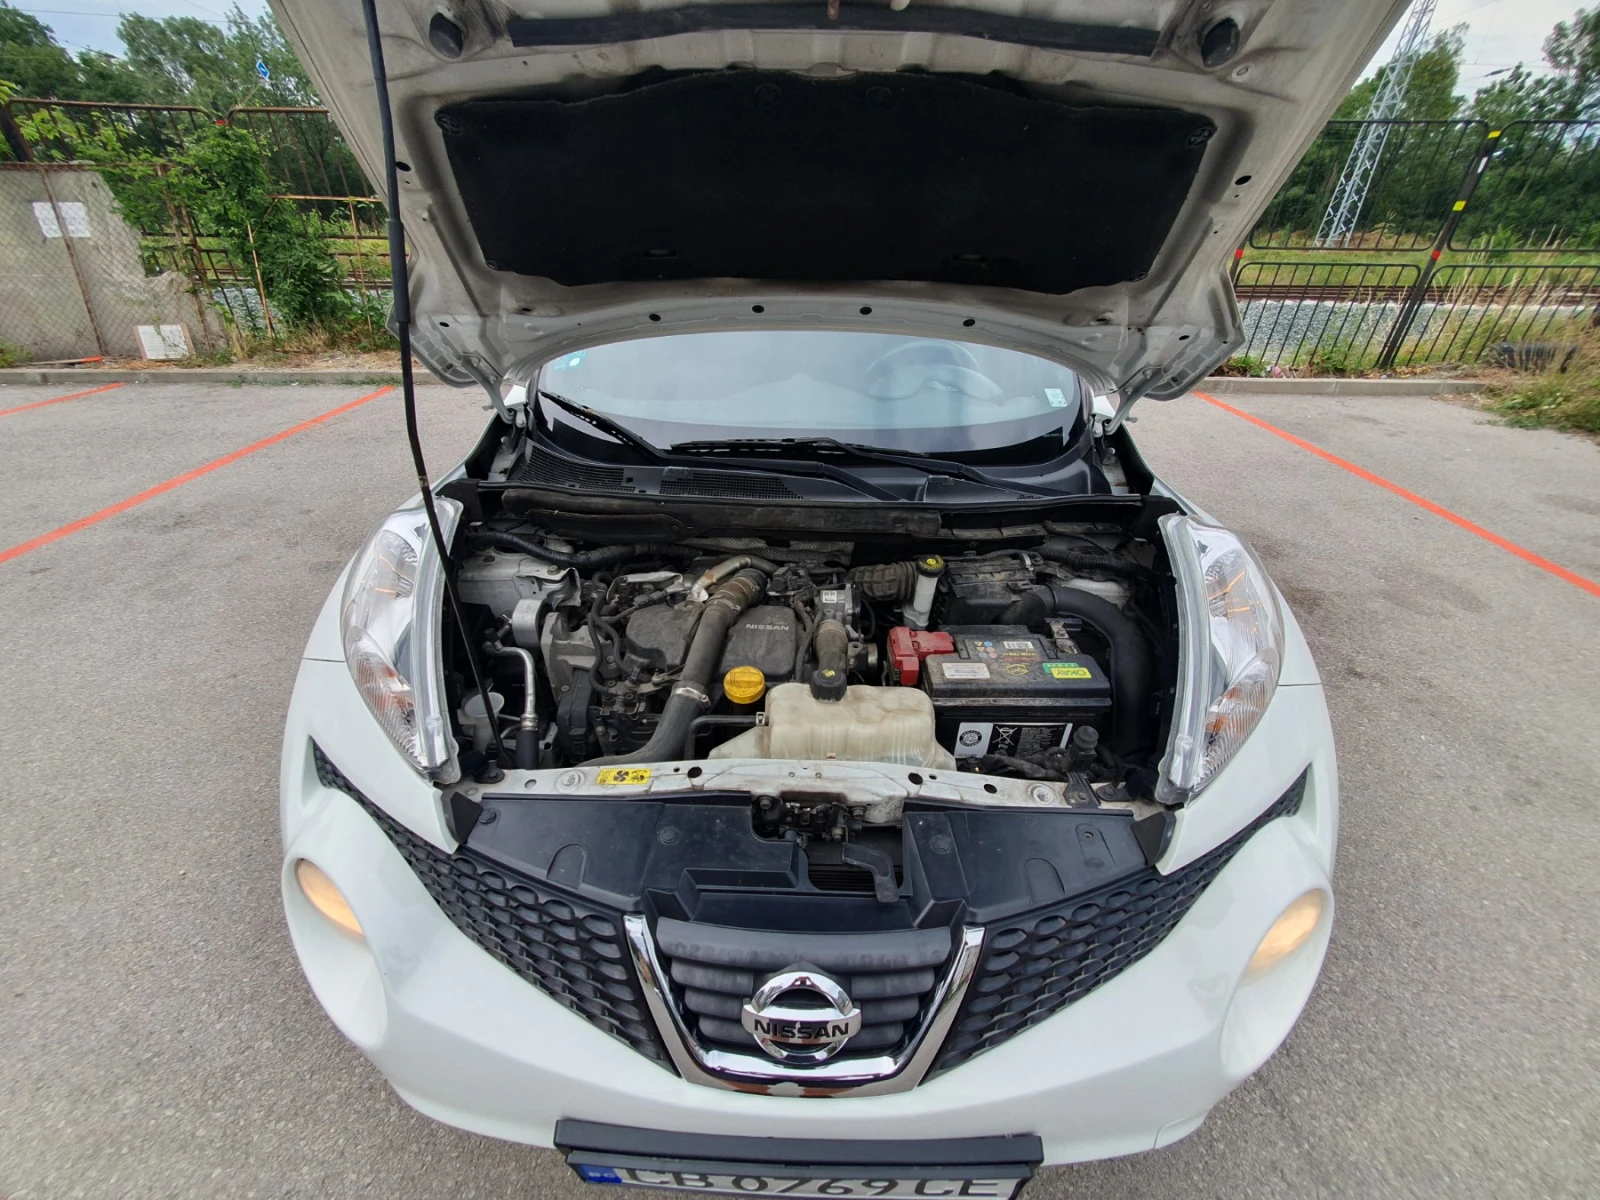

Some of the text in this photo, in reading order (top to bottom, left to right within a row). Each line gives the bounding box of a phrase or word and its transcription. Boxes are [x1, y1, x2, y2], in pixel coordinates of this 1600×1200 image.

[745, 623, 790, 631] NISSAN
[1056, 669, 1088, 677] OKAY
[754, 1019, 849, 1040] NISSAN
[731, 1174, 899, 1198] 0769
[913, 1177, 999, 1198] CE
